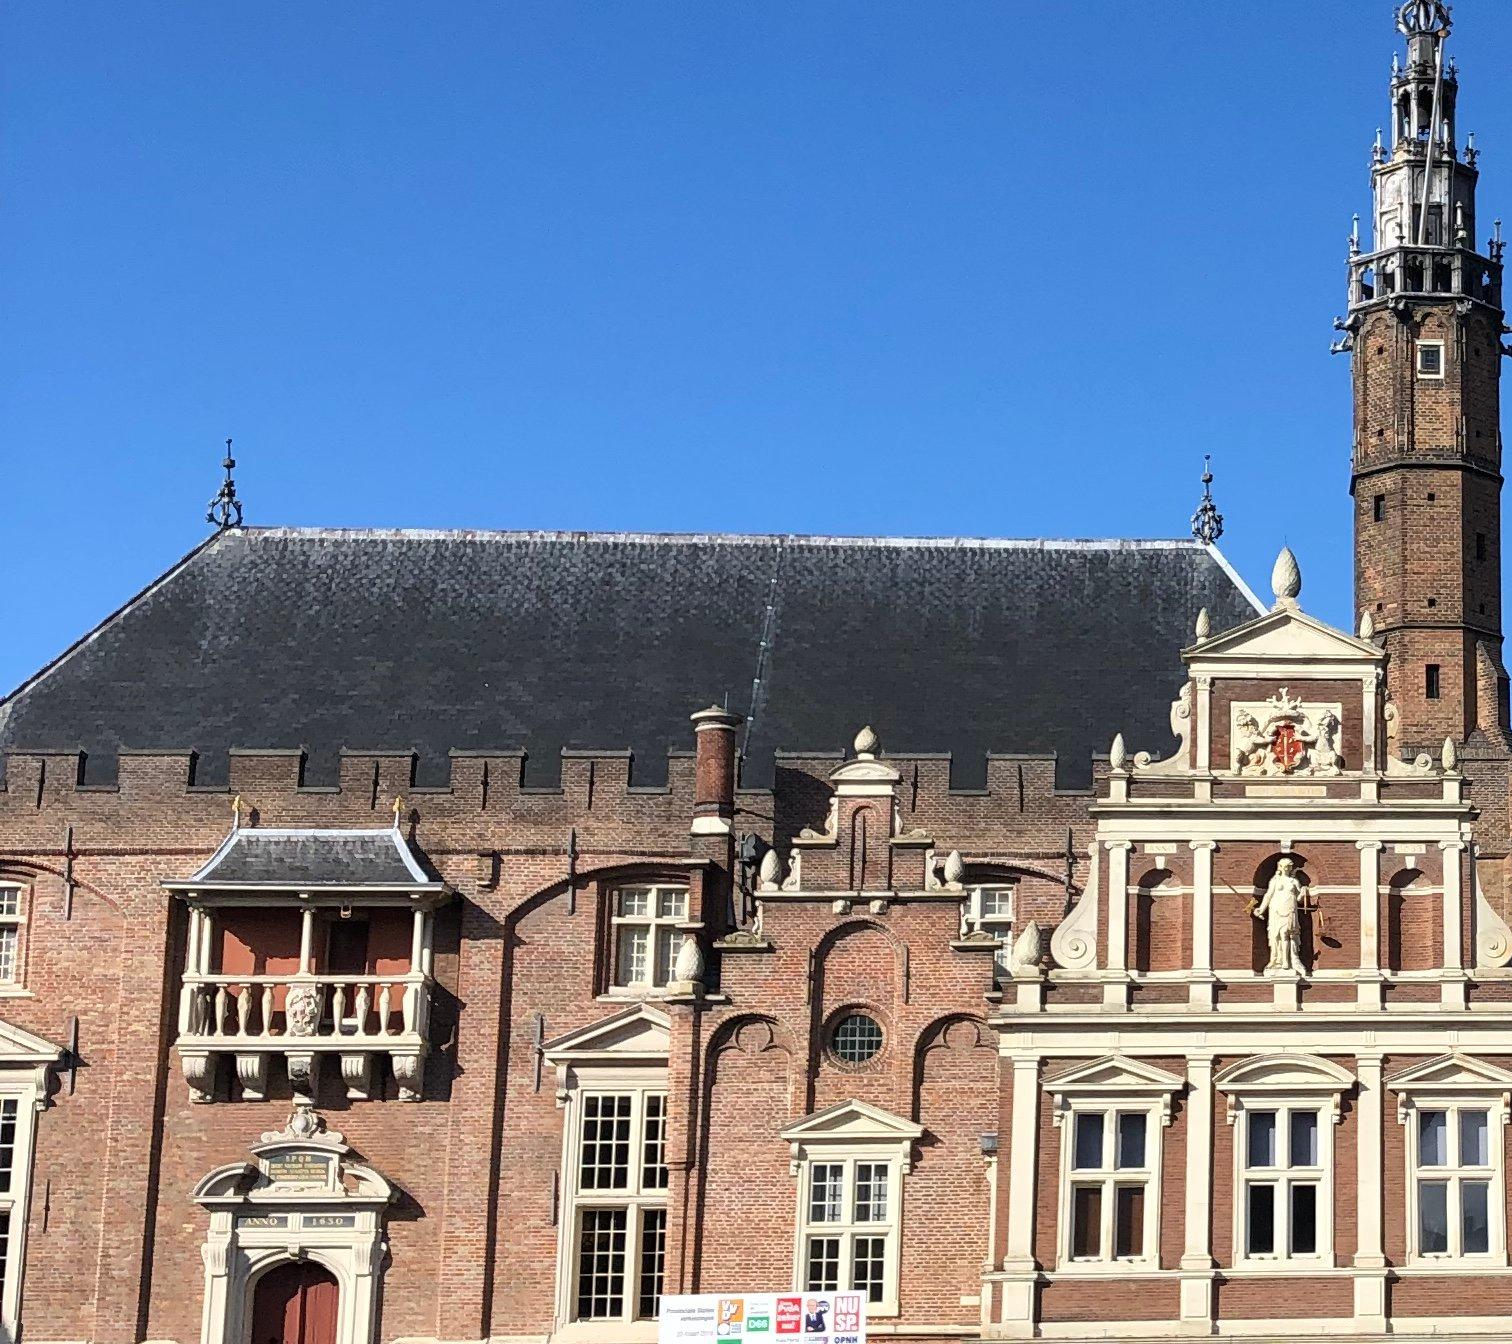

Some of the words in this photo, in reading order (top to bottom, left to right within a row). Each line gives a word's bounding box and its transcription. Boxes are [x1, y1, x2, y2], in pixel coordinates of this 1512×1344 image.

[244, 1217, 278, 1226] ANNO
[312, 1217, 344, 1226] 1630
[836, 1297, 858, 1313] NU
[748, 1319, 768, 1329] D66
